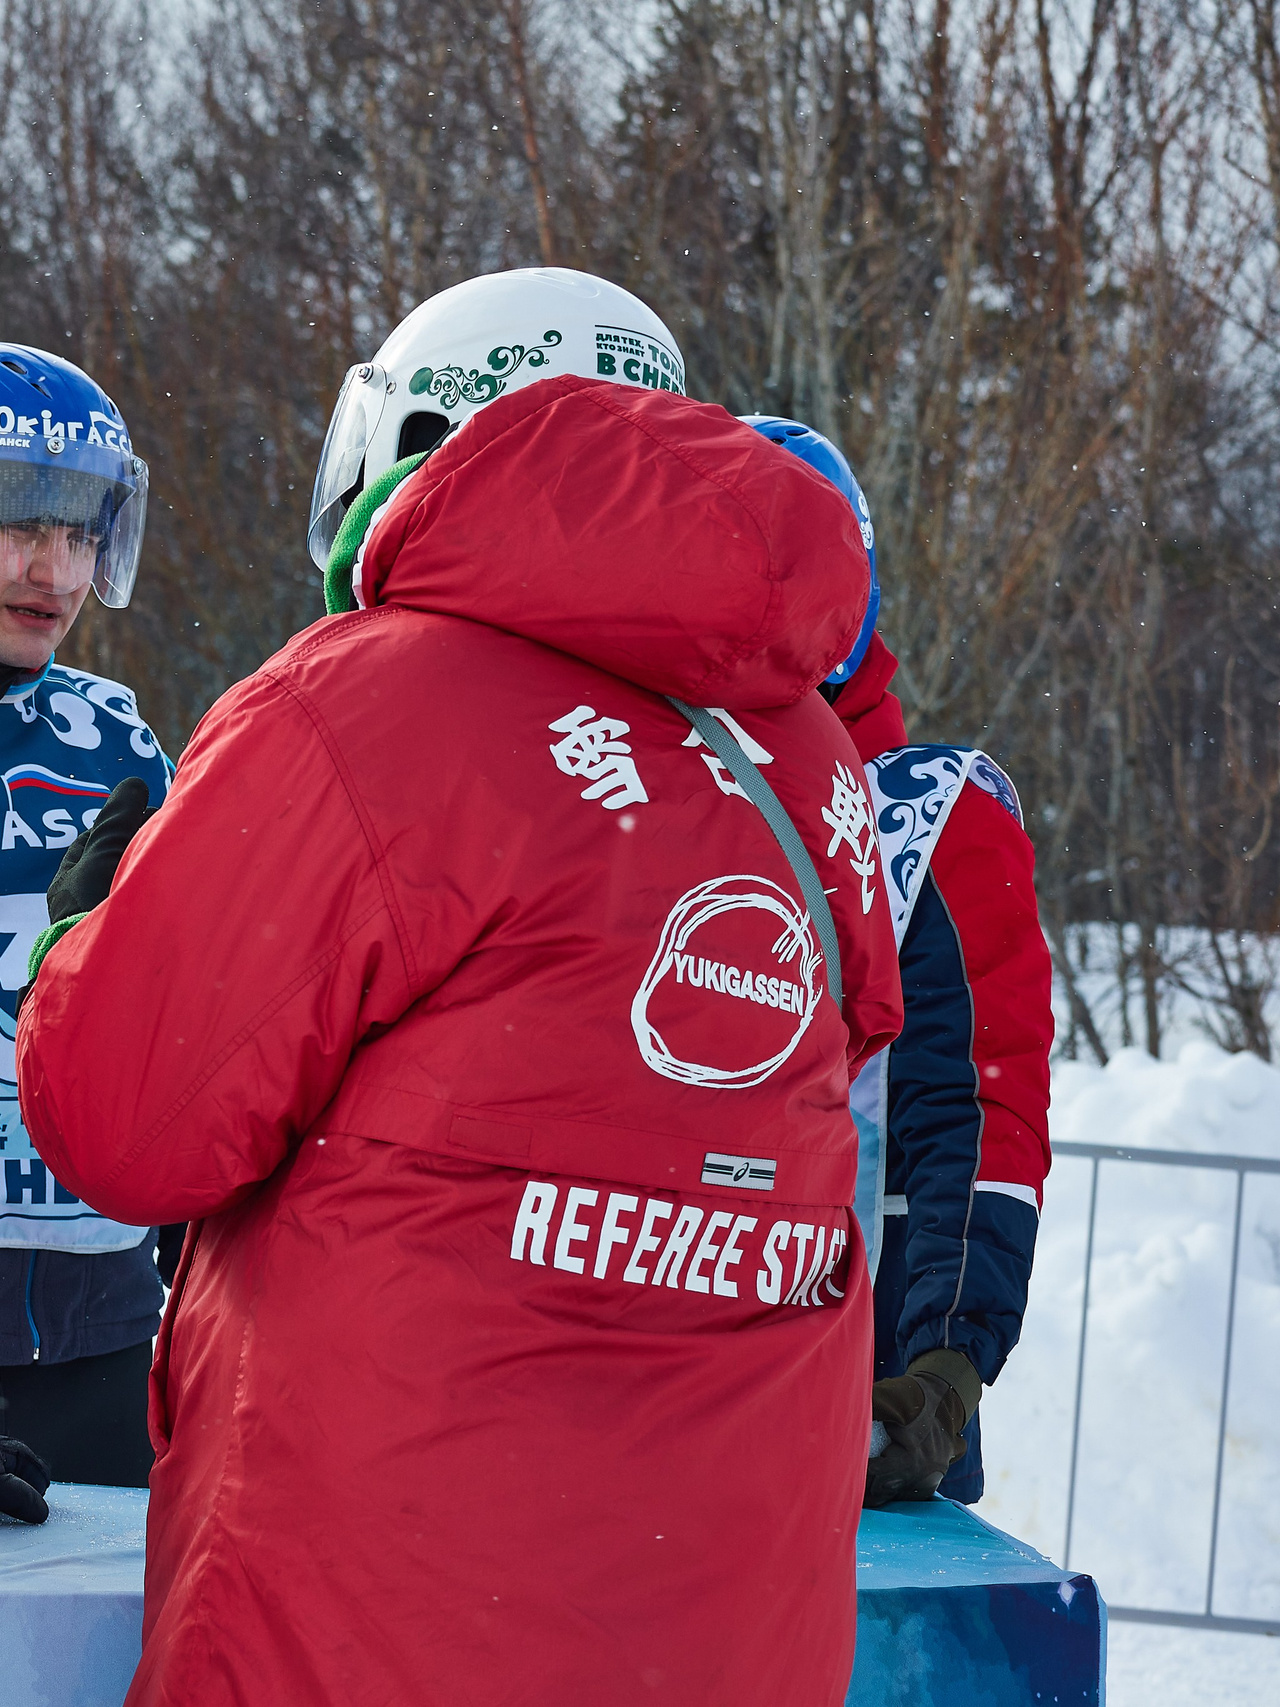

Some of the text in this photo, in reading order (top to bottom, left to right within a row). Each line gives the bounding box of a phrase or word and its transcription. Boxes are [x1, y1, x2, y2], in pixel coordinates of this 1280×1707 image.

[596, 333, 619, 342] ДЛЯ
[596, 343, 616, 351] КТО
[597, 352, 617, 376] В
[673, 951, 805, 1017] YUKIGASSEN
[510, 1180, 758, 1298] REFEREE
